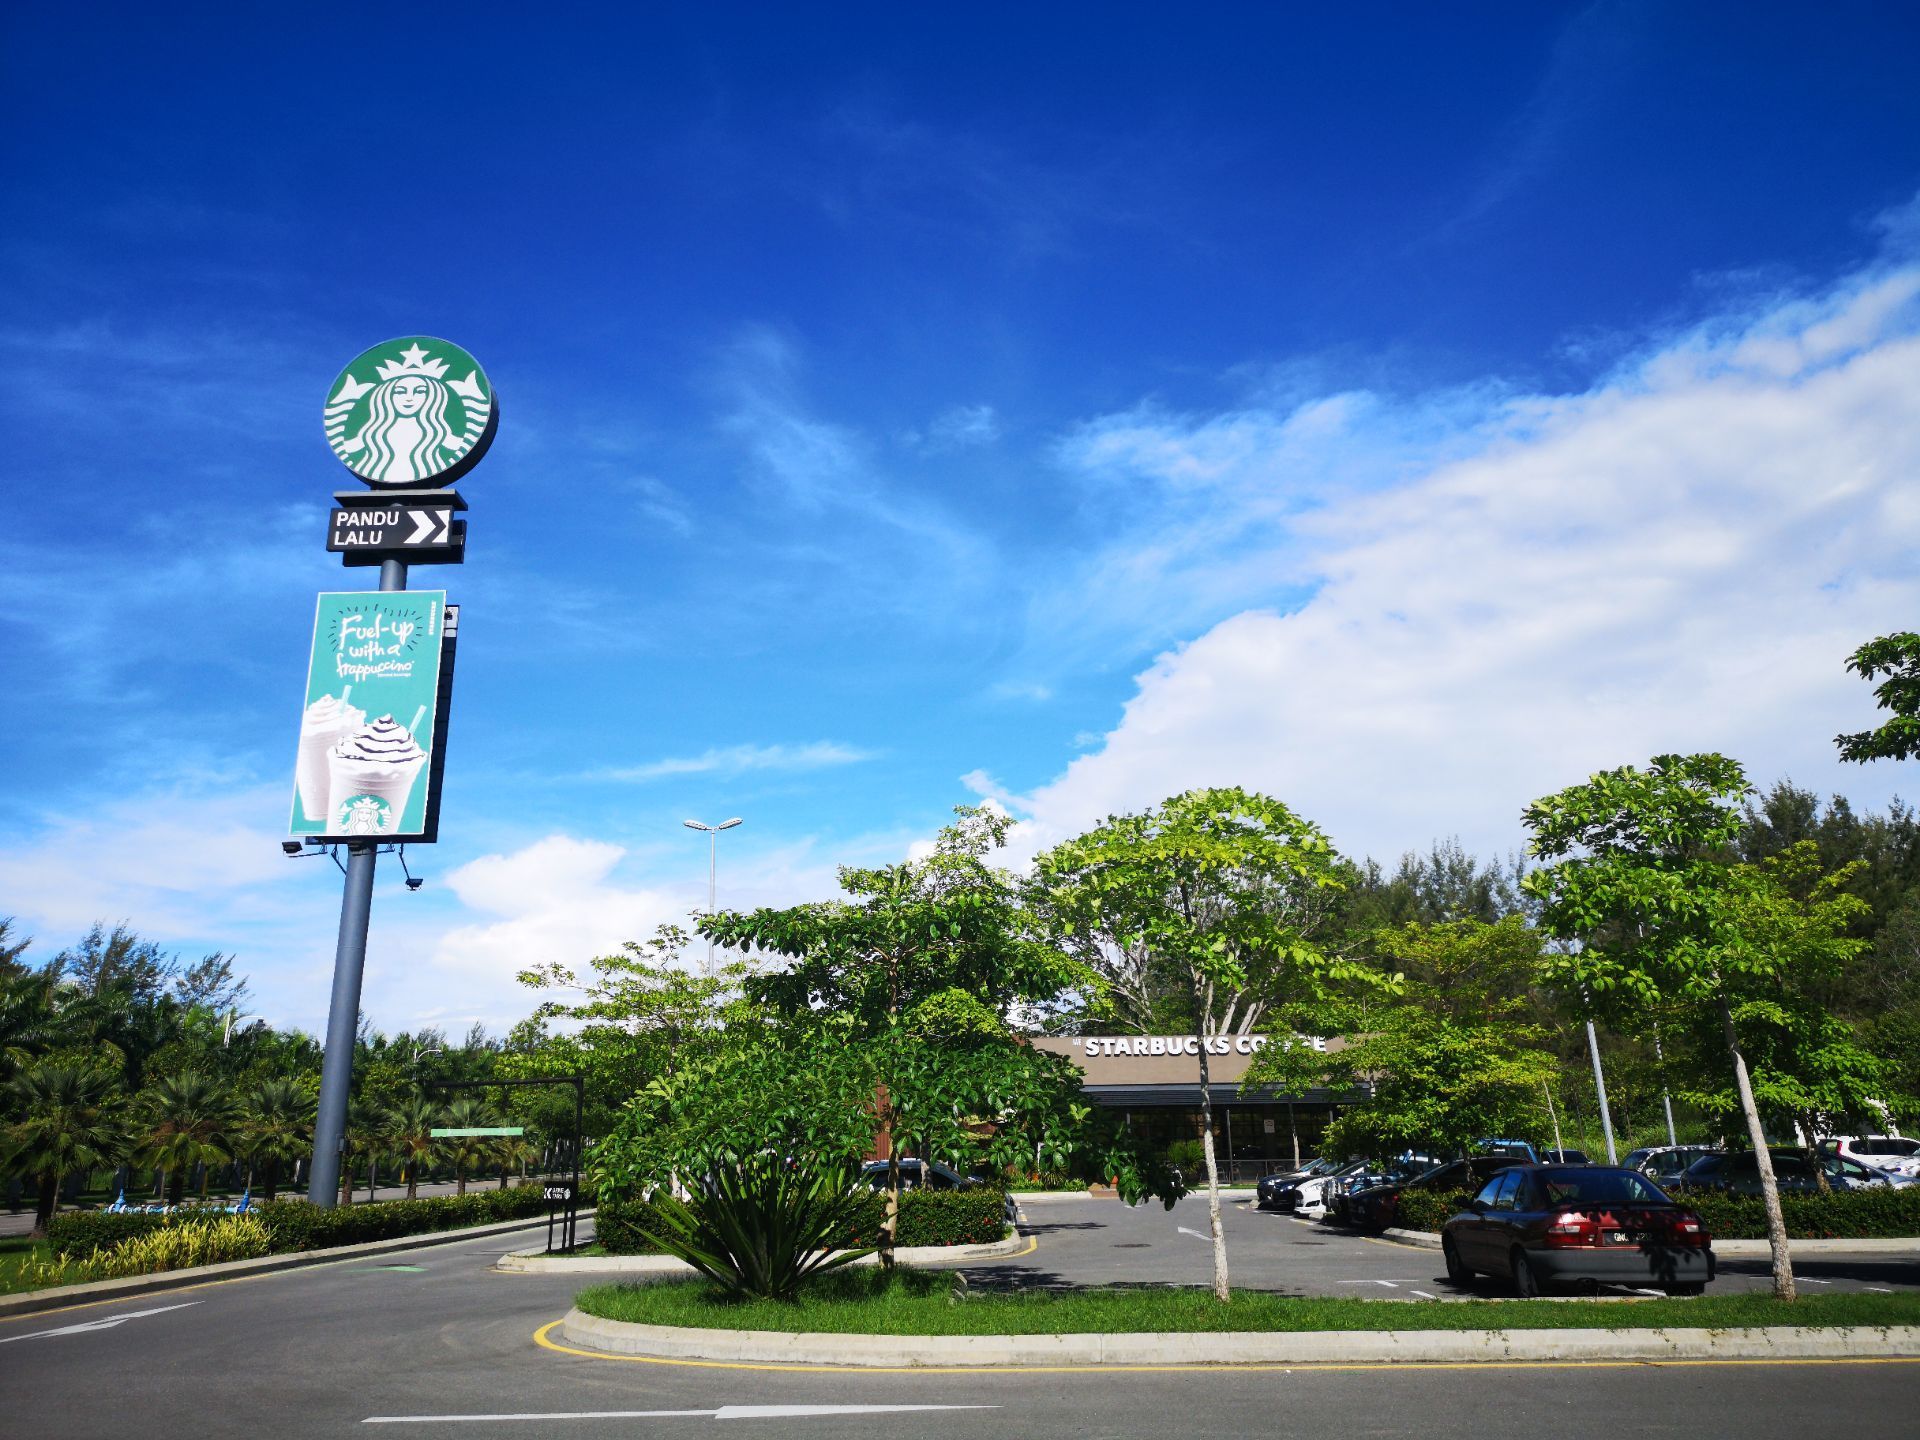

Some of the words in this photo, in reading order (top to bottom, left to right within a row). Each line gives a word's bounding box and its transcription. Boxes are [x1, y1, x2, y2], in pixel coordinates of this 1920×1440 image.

[336, 511, 399, 527] PANDU
[334, 530, 382, 546] LALU
[339, 613, 415, 650] Fuel-up
[349, 641, 385, 662] with
[387, 644, 401, 657] a
[336, 653, 413, 683] frappuccino
[1085, 1037, 1231, 1056] STARBUCKS
[1236, 1035, 1327, 1055] COE
